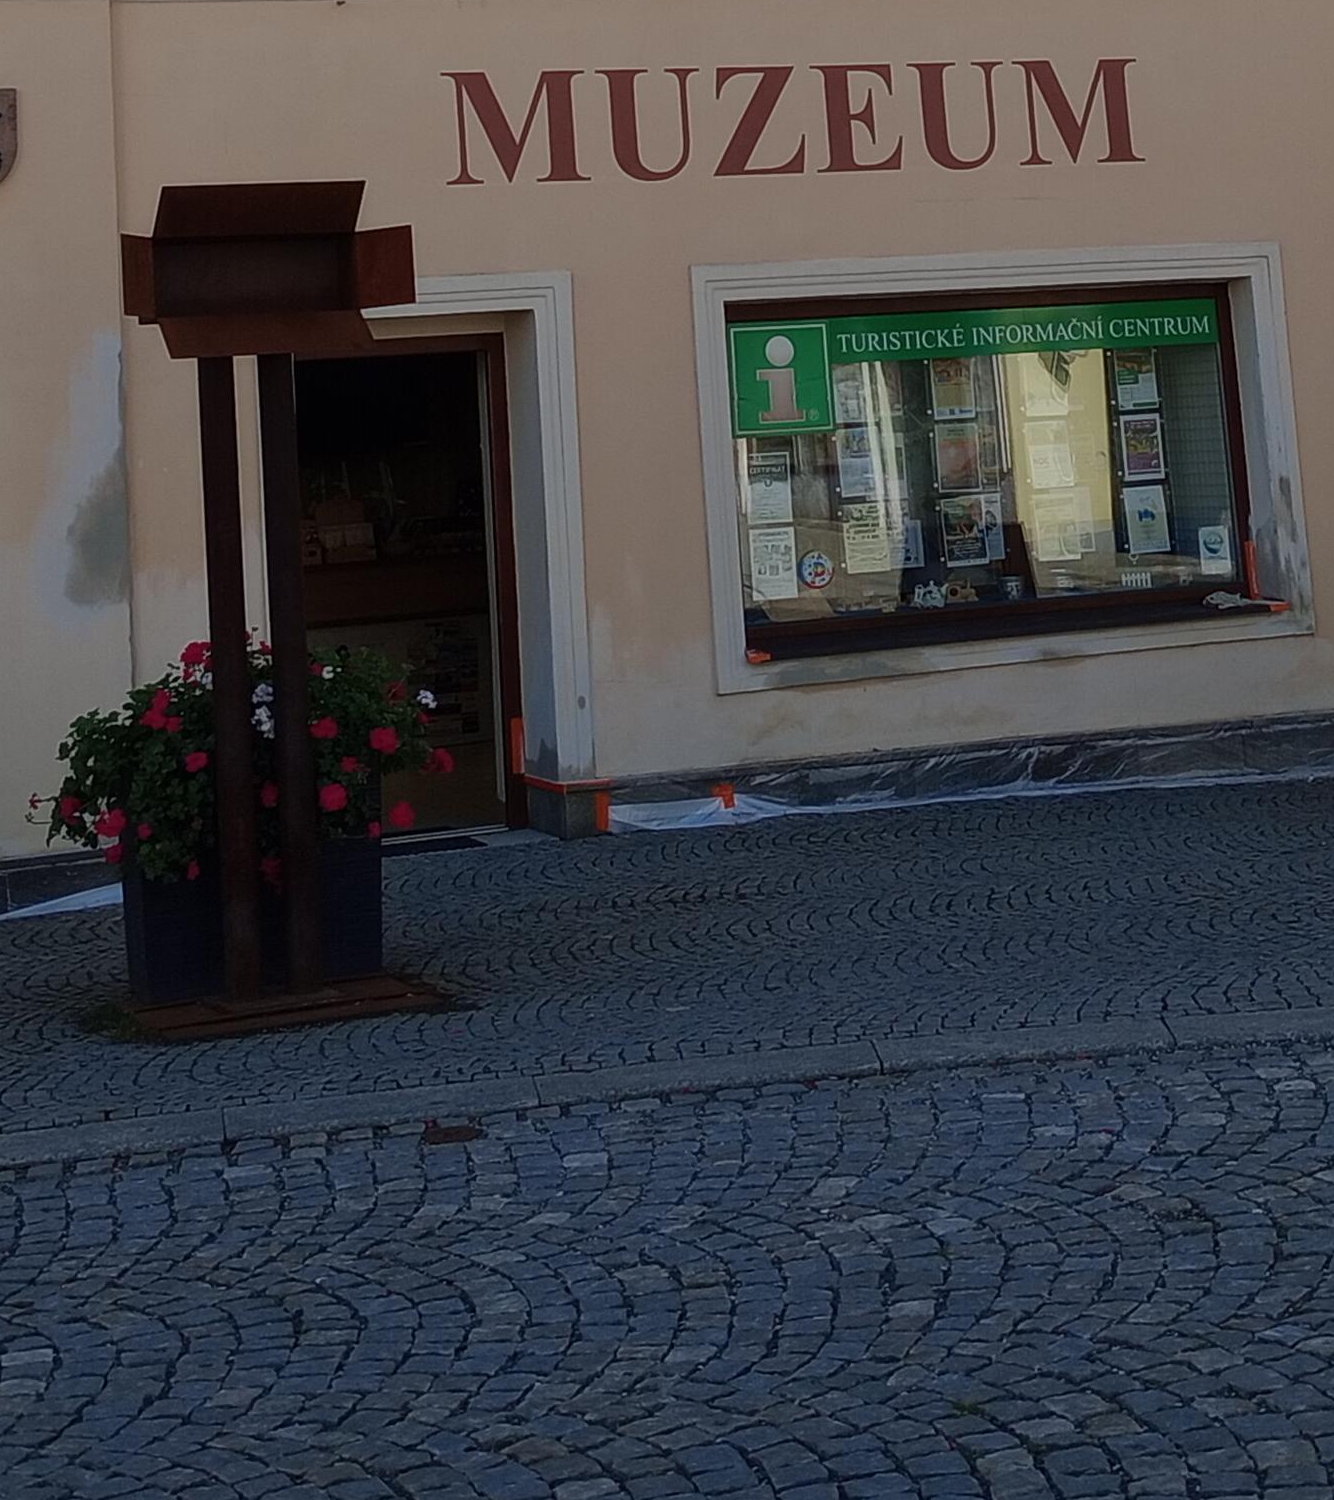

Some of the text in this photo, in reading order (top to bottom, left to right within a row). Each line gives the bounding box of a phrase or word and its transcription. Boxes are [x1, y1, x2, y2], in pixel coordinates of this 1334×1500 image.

[440, 57, 1146, 186] MUZEUM
[836, 315, 1211, 354] TURISTICKÉ INFORMAČNÍ CENTRUM
